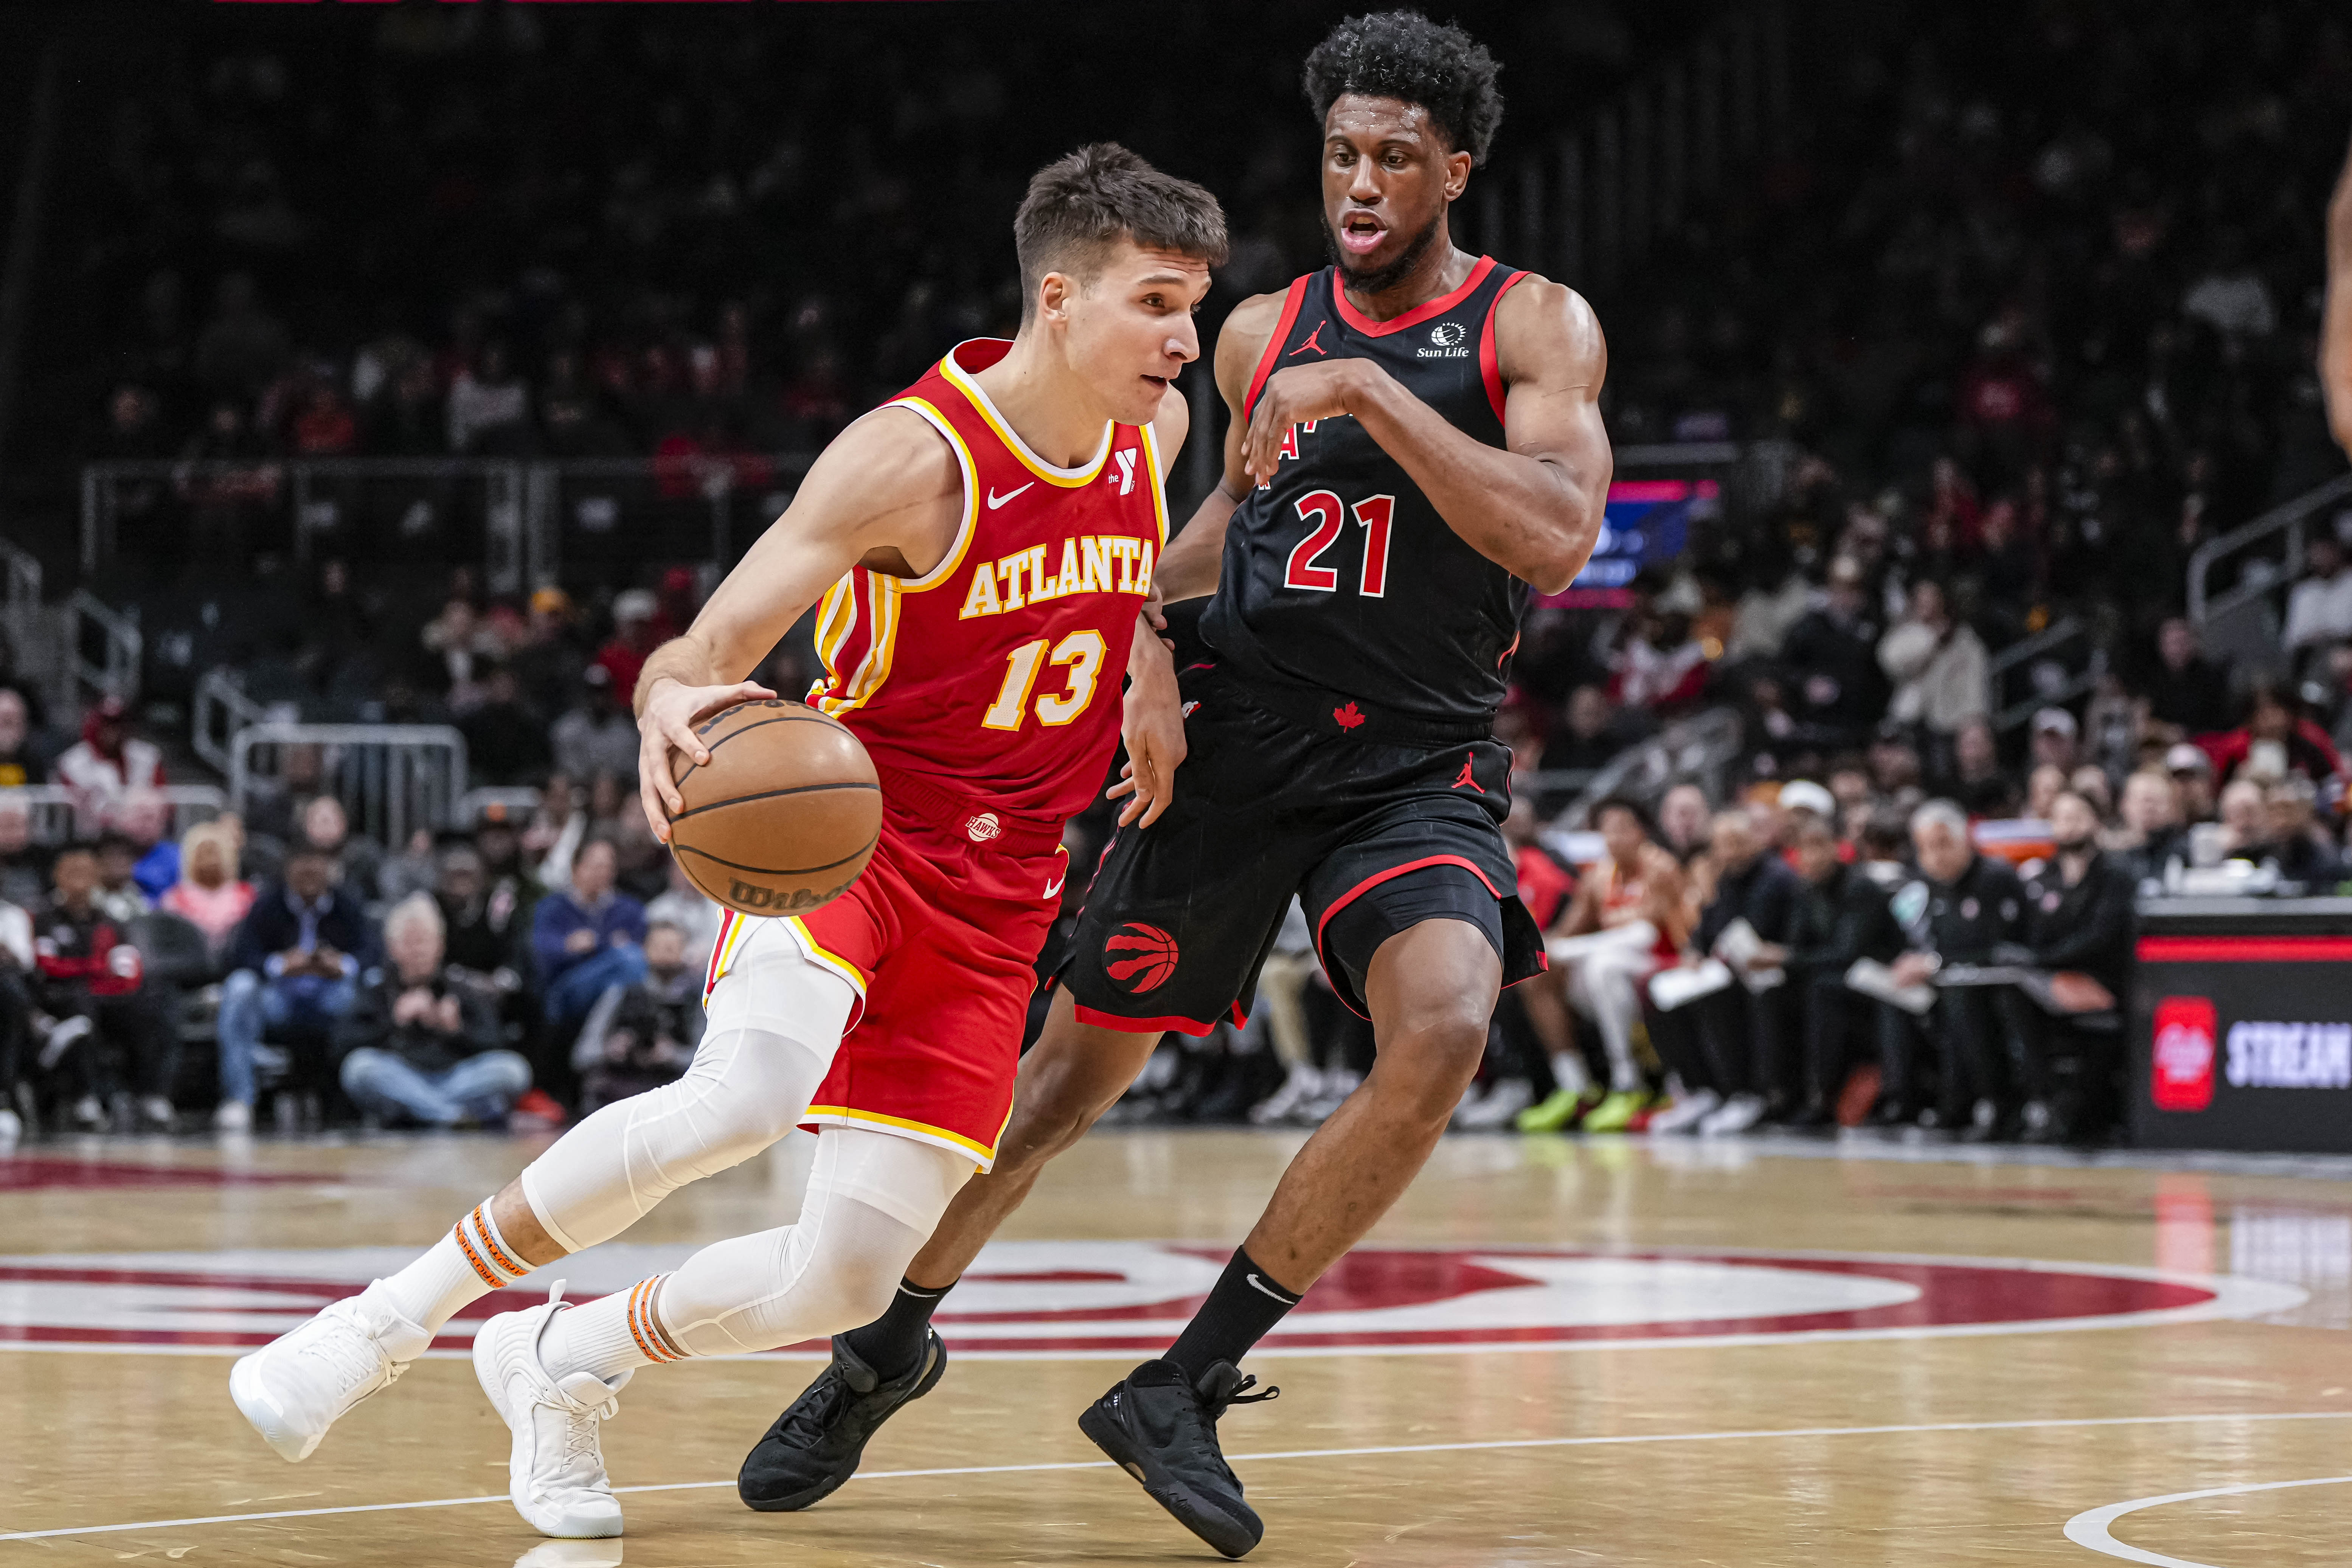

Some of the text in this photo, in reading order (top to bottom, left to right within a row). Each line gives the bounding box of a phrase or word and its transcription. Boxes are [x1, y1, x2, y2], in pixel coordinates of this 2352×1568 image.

[1417, 347, 1469, 357] Sun Life
[1108, 448, 1136, 496] the Y
[1284, 489, 1395, 598] 21
[959, 535, 1153, 621] ATLANTA
[981, 629, 1108, 731] 13
[966, 817, 1001, 838] HAWKS
